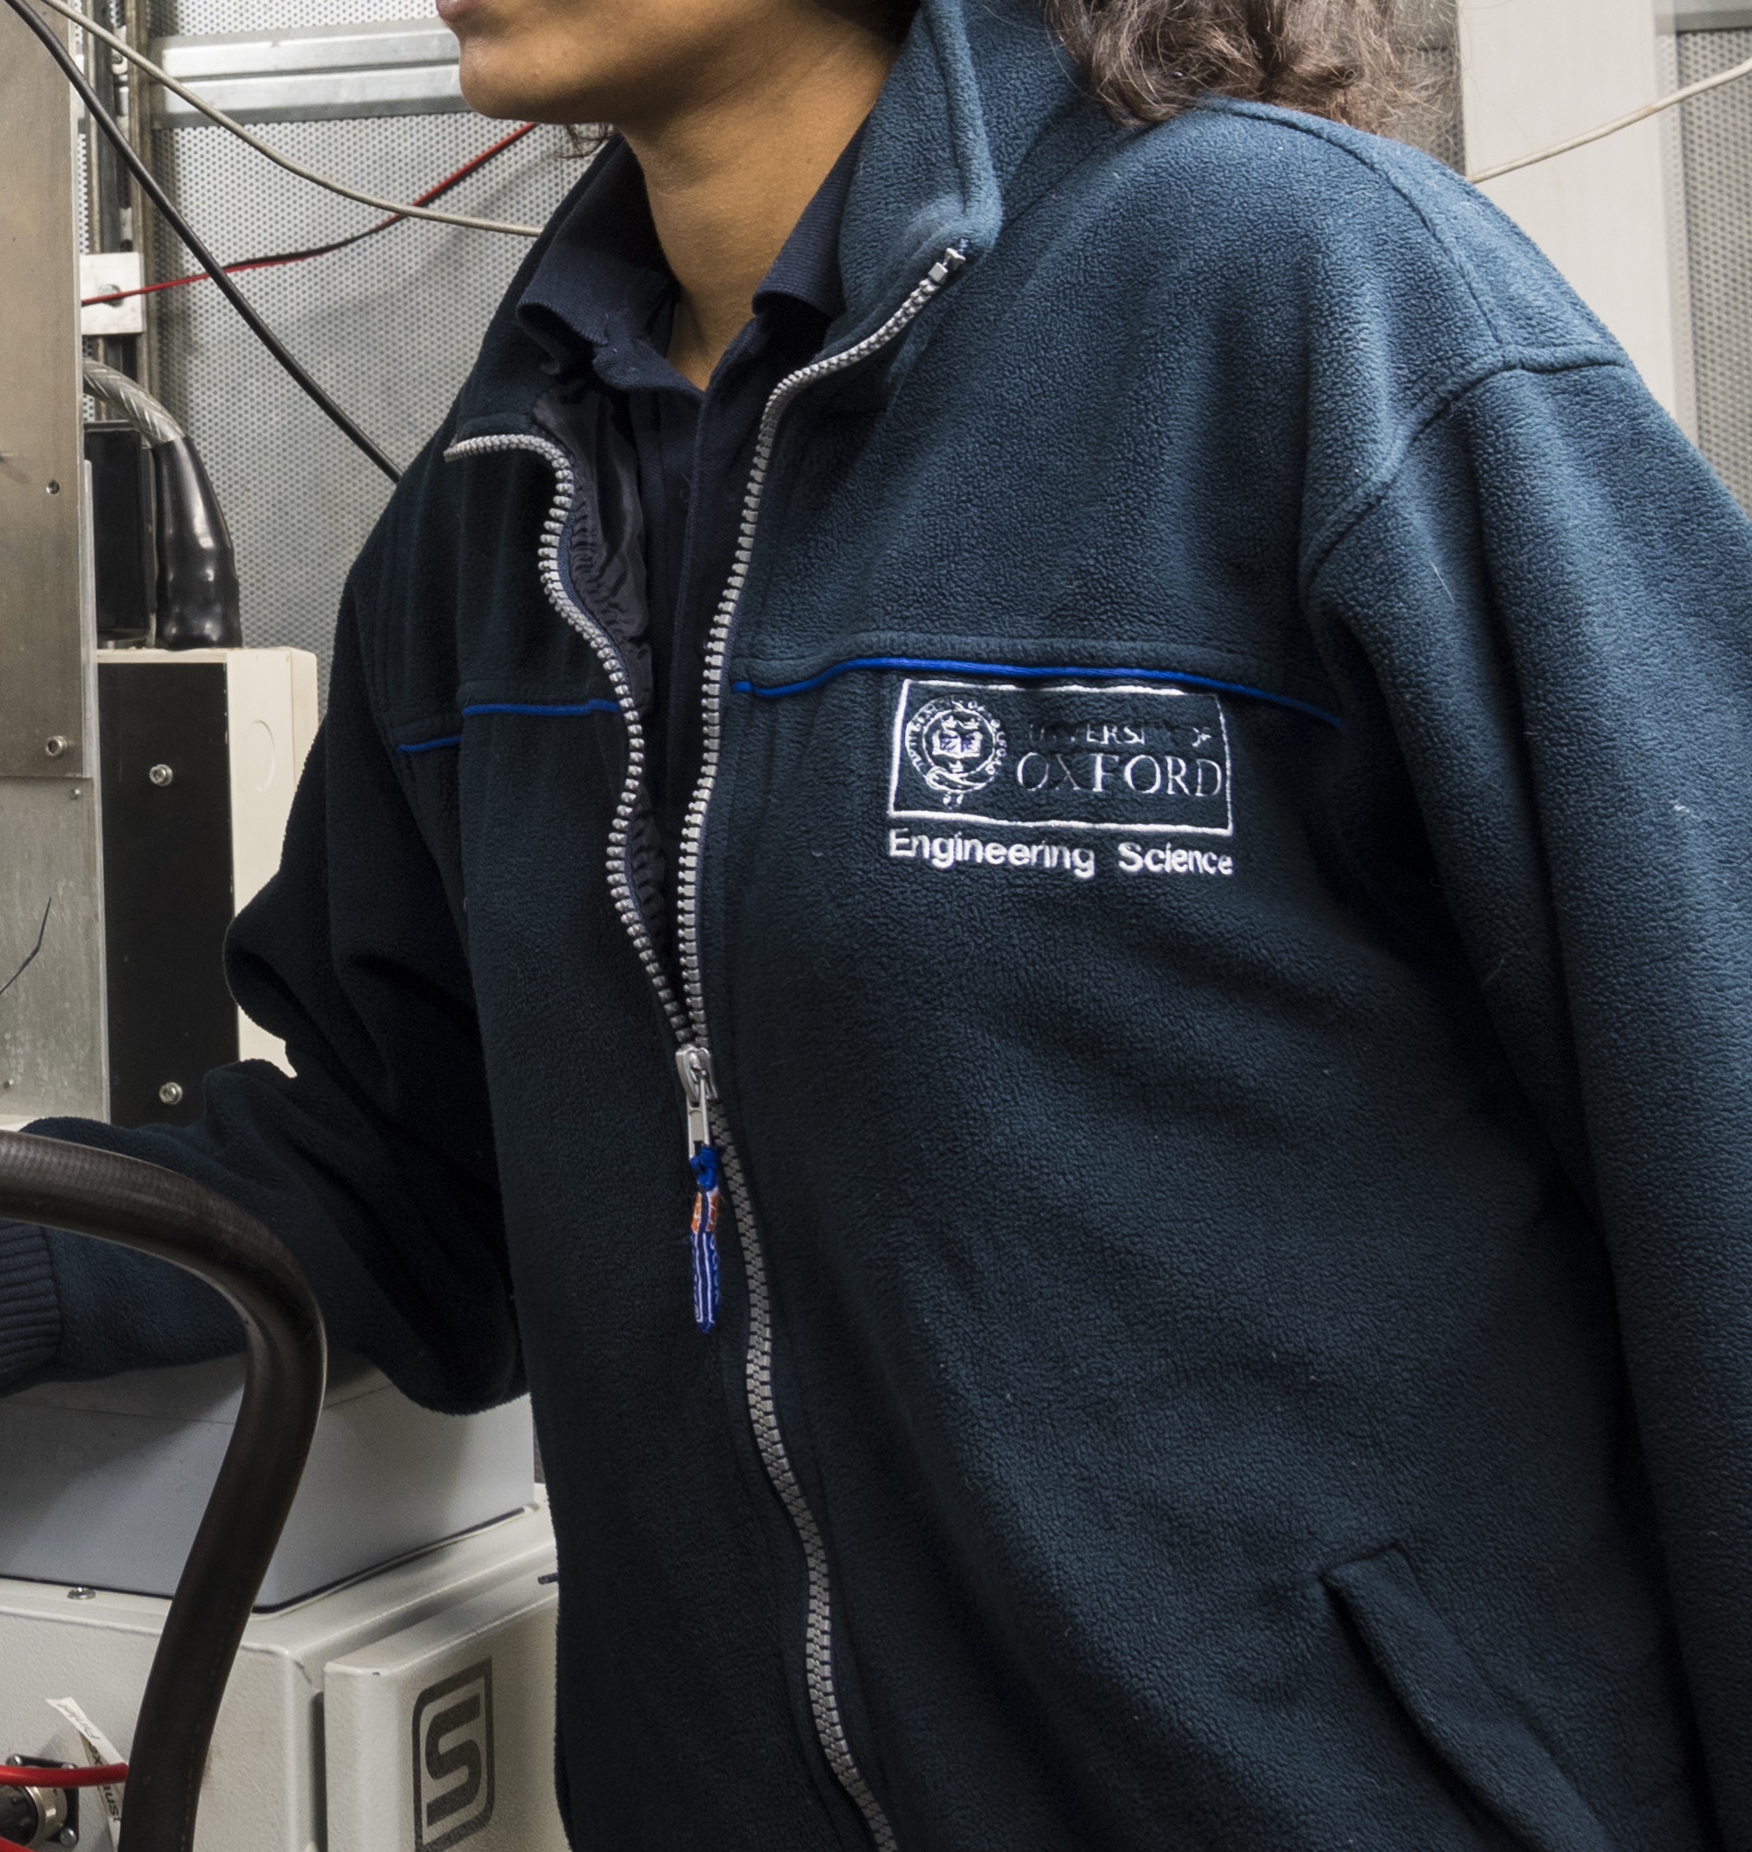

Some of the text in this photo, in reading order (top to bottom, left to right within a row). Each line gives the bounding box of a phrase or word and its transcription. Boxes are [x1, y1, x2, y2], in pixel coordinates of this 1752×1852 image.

[1017, 752, 1222, 797] OXFORD
[889, 829, 1234, 879] Engineering Science
